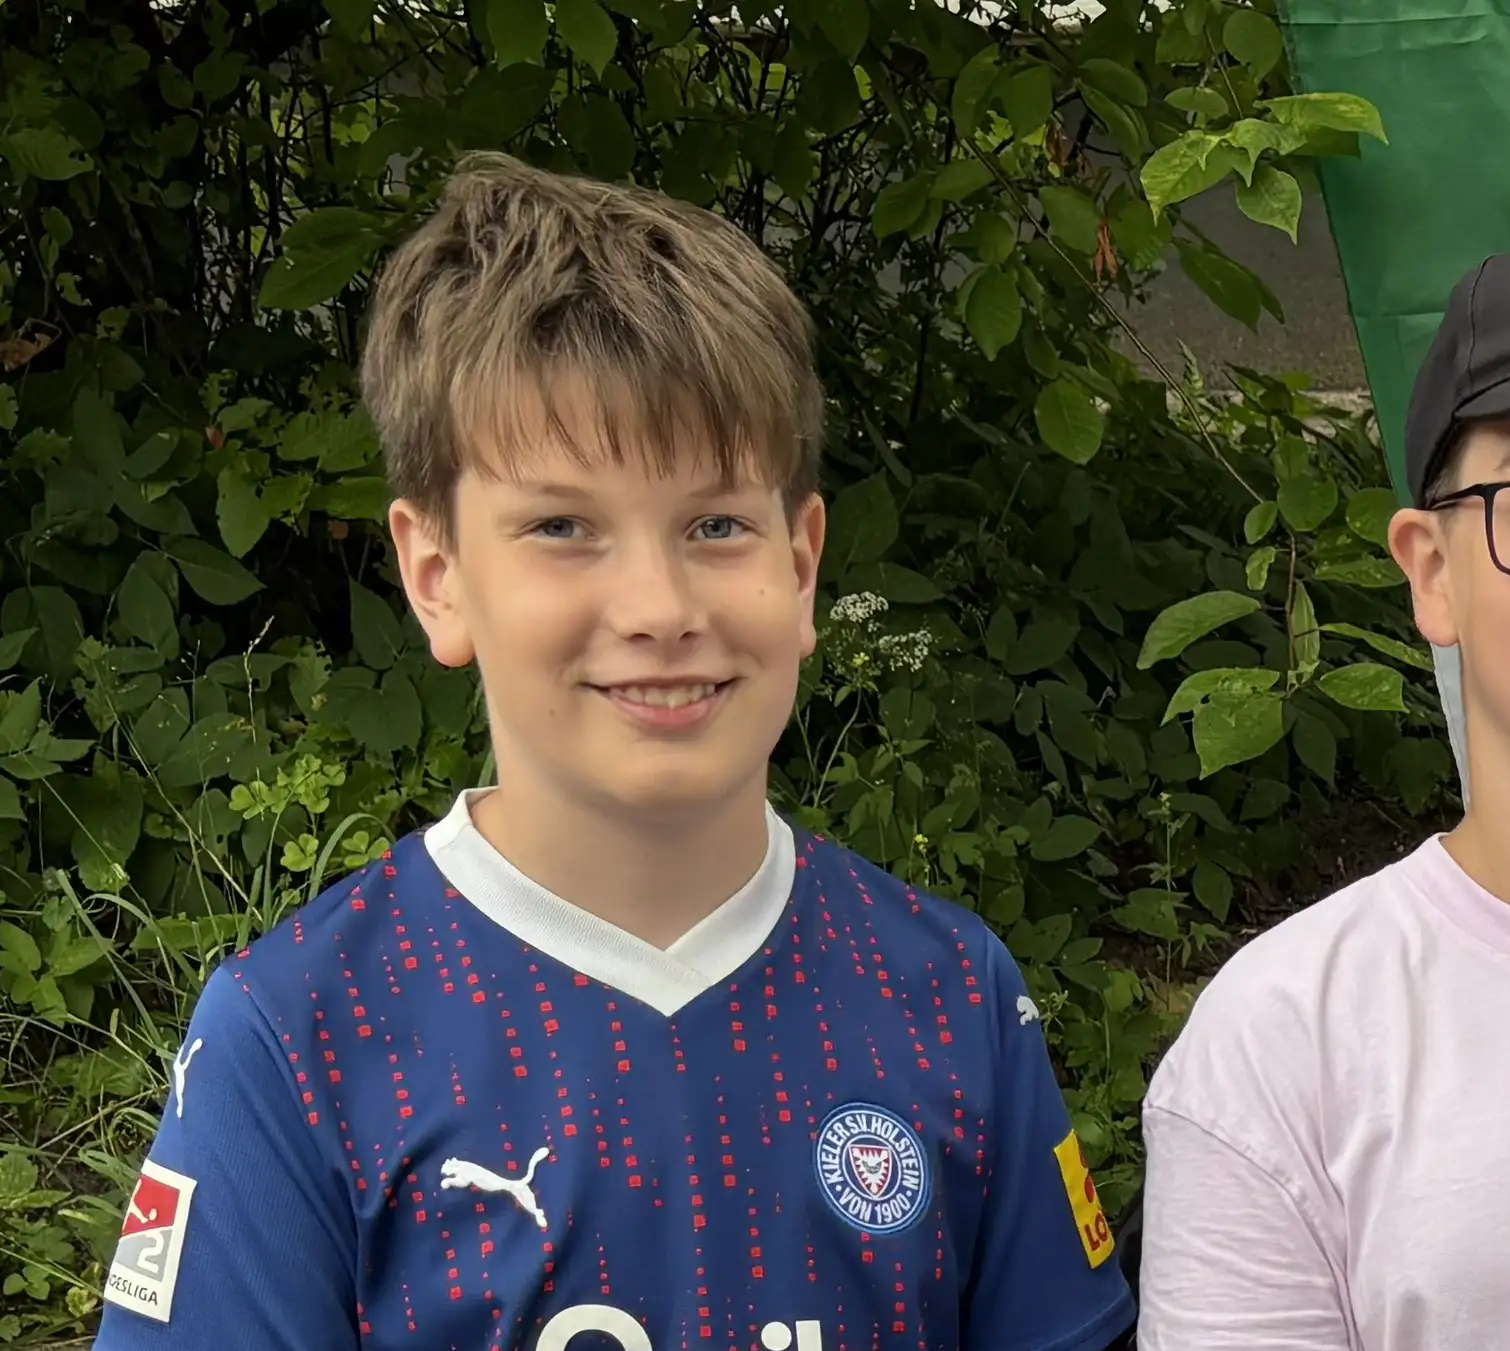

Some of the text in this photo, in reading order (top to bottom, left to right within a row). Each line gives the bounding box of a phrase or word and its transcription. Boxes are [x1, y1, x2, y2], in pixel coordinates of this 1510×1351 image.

[821, 1123, 853, 1185] KIELER
[871, 1115, 920, 1191] HOLSTEIN
[838, 1186, 911, 1224] VON 1900
[137, 1230, 165, 1274] 2
